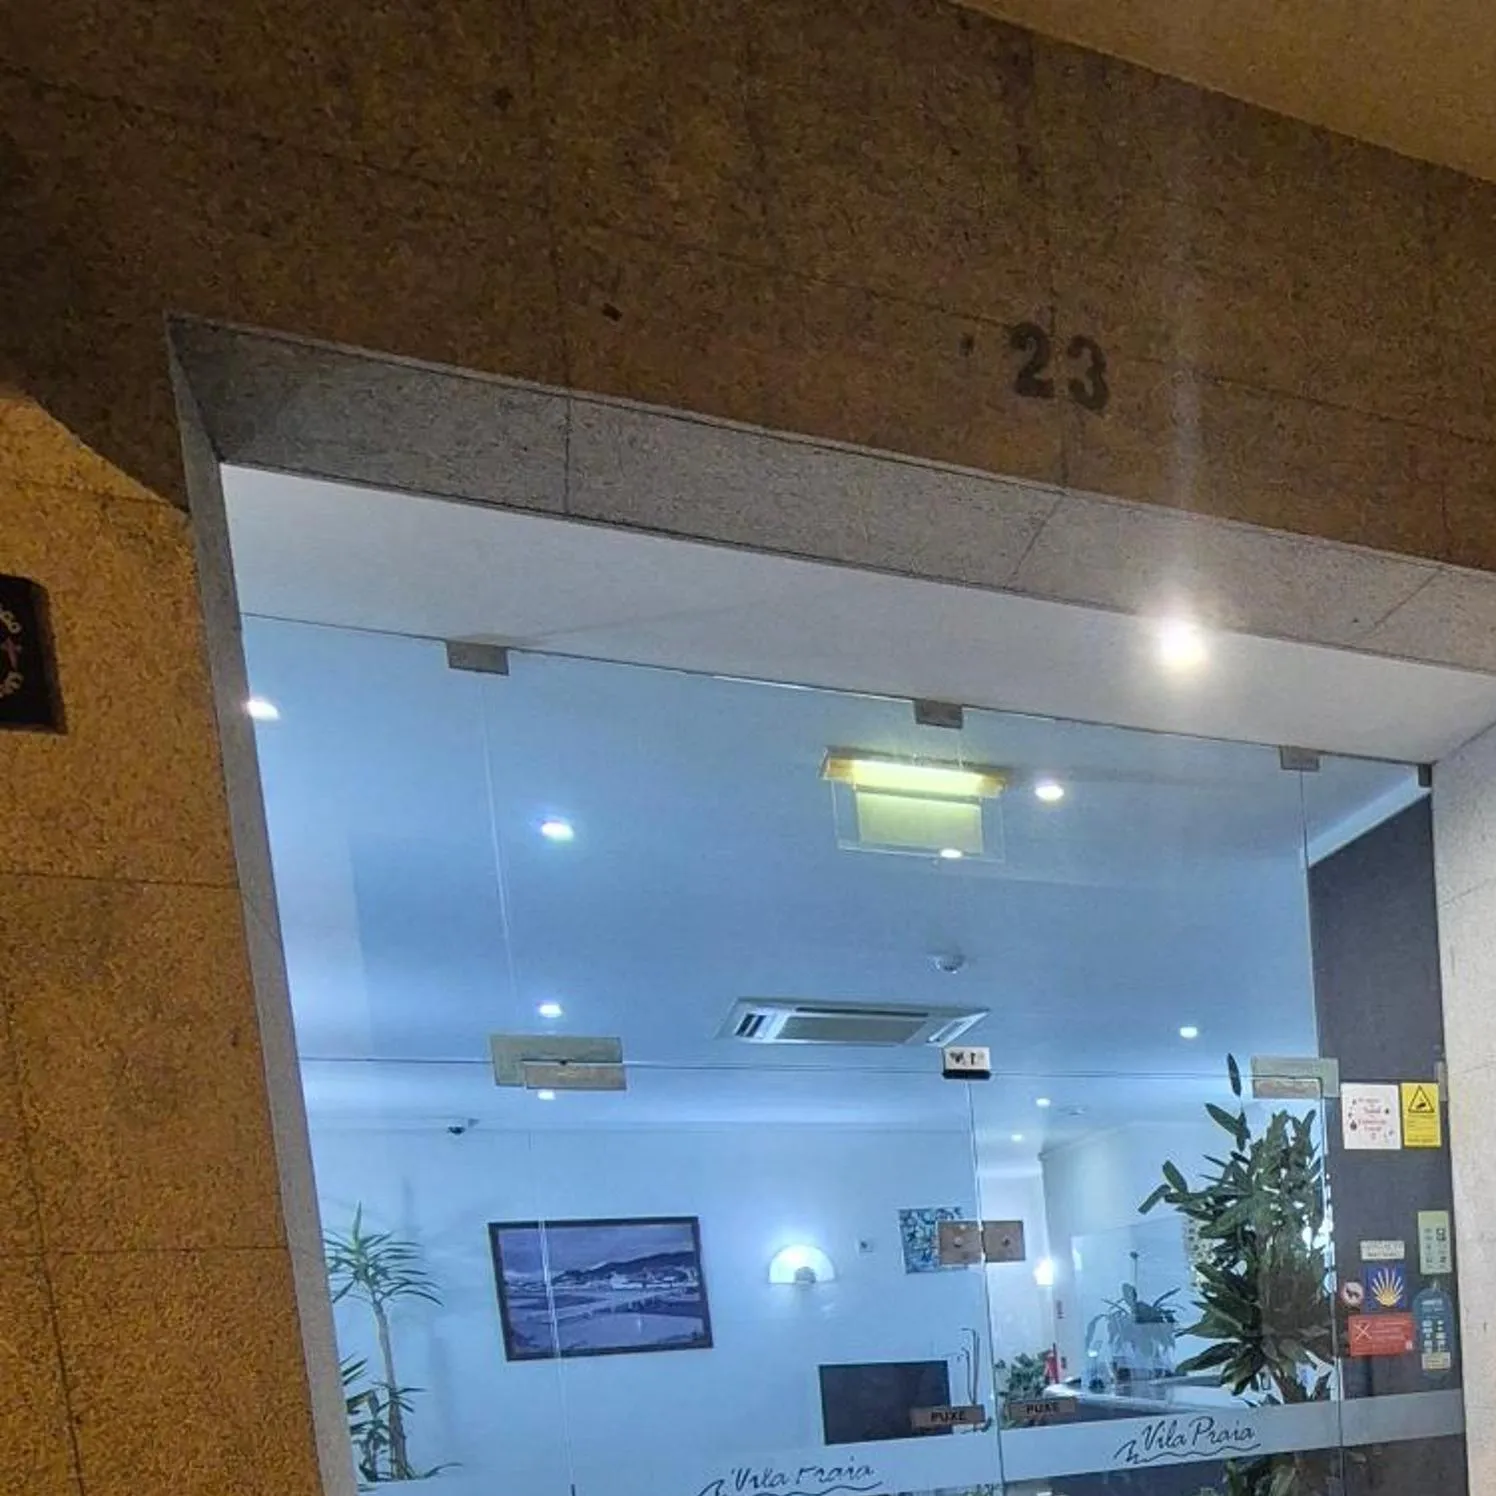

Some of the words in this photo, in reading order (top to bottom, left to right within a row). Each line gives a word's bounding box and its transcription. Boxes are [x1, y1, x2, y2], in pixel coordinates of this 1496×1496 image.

[1009, 321, 1109, 411] 23
[930, 1410, 967, 1423] PUXE
[1025, 1400, 1061, 1415] PUXE
[1141, 1420, 1189, 1451] Vila
[1189, 1415, 1257, 1447] Praia
